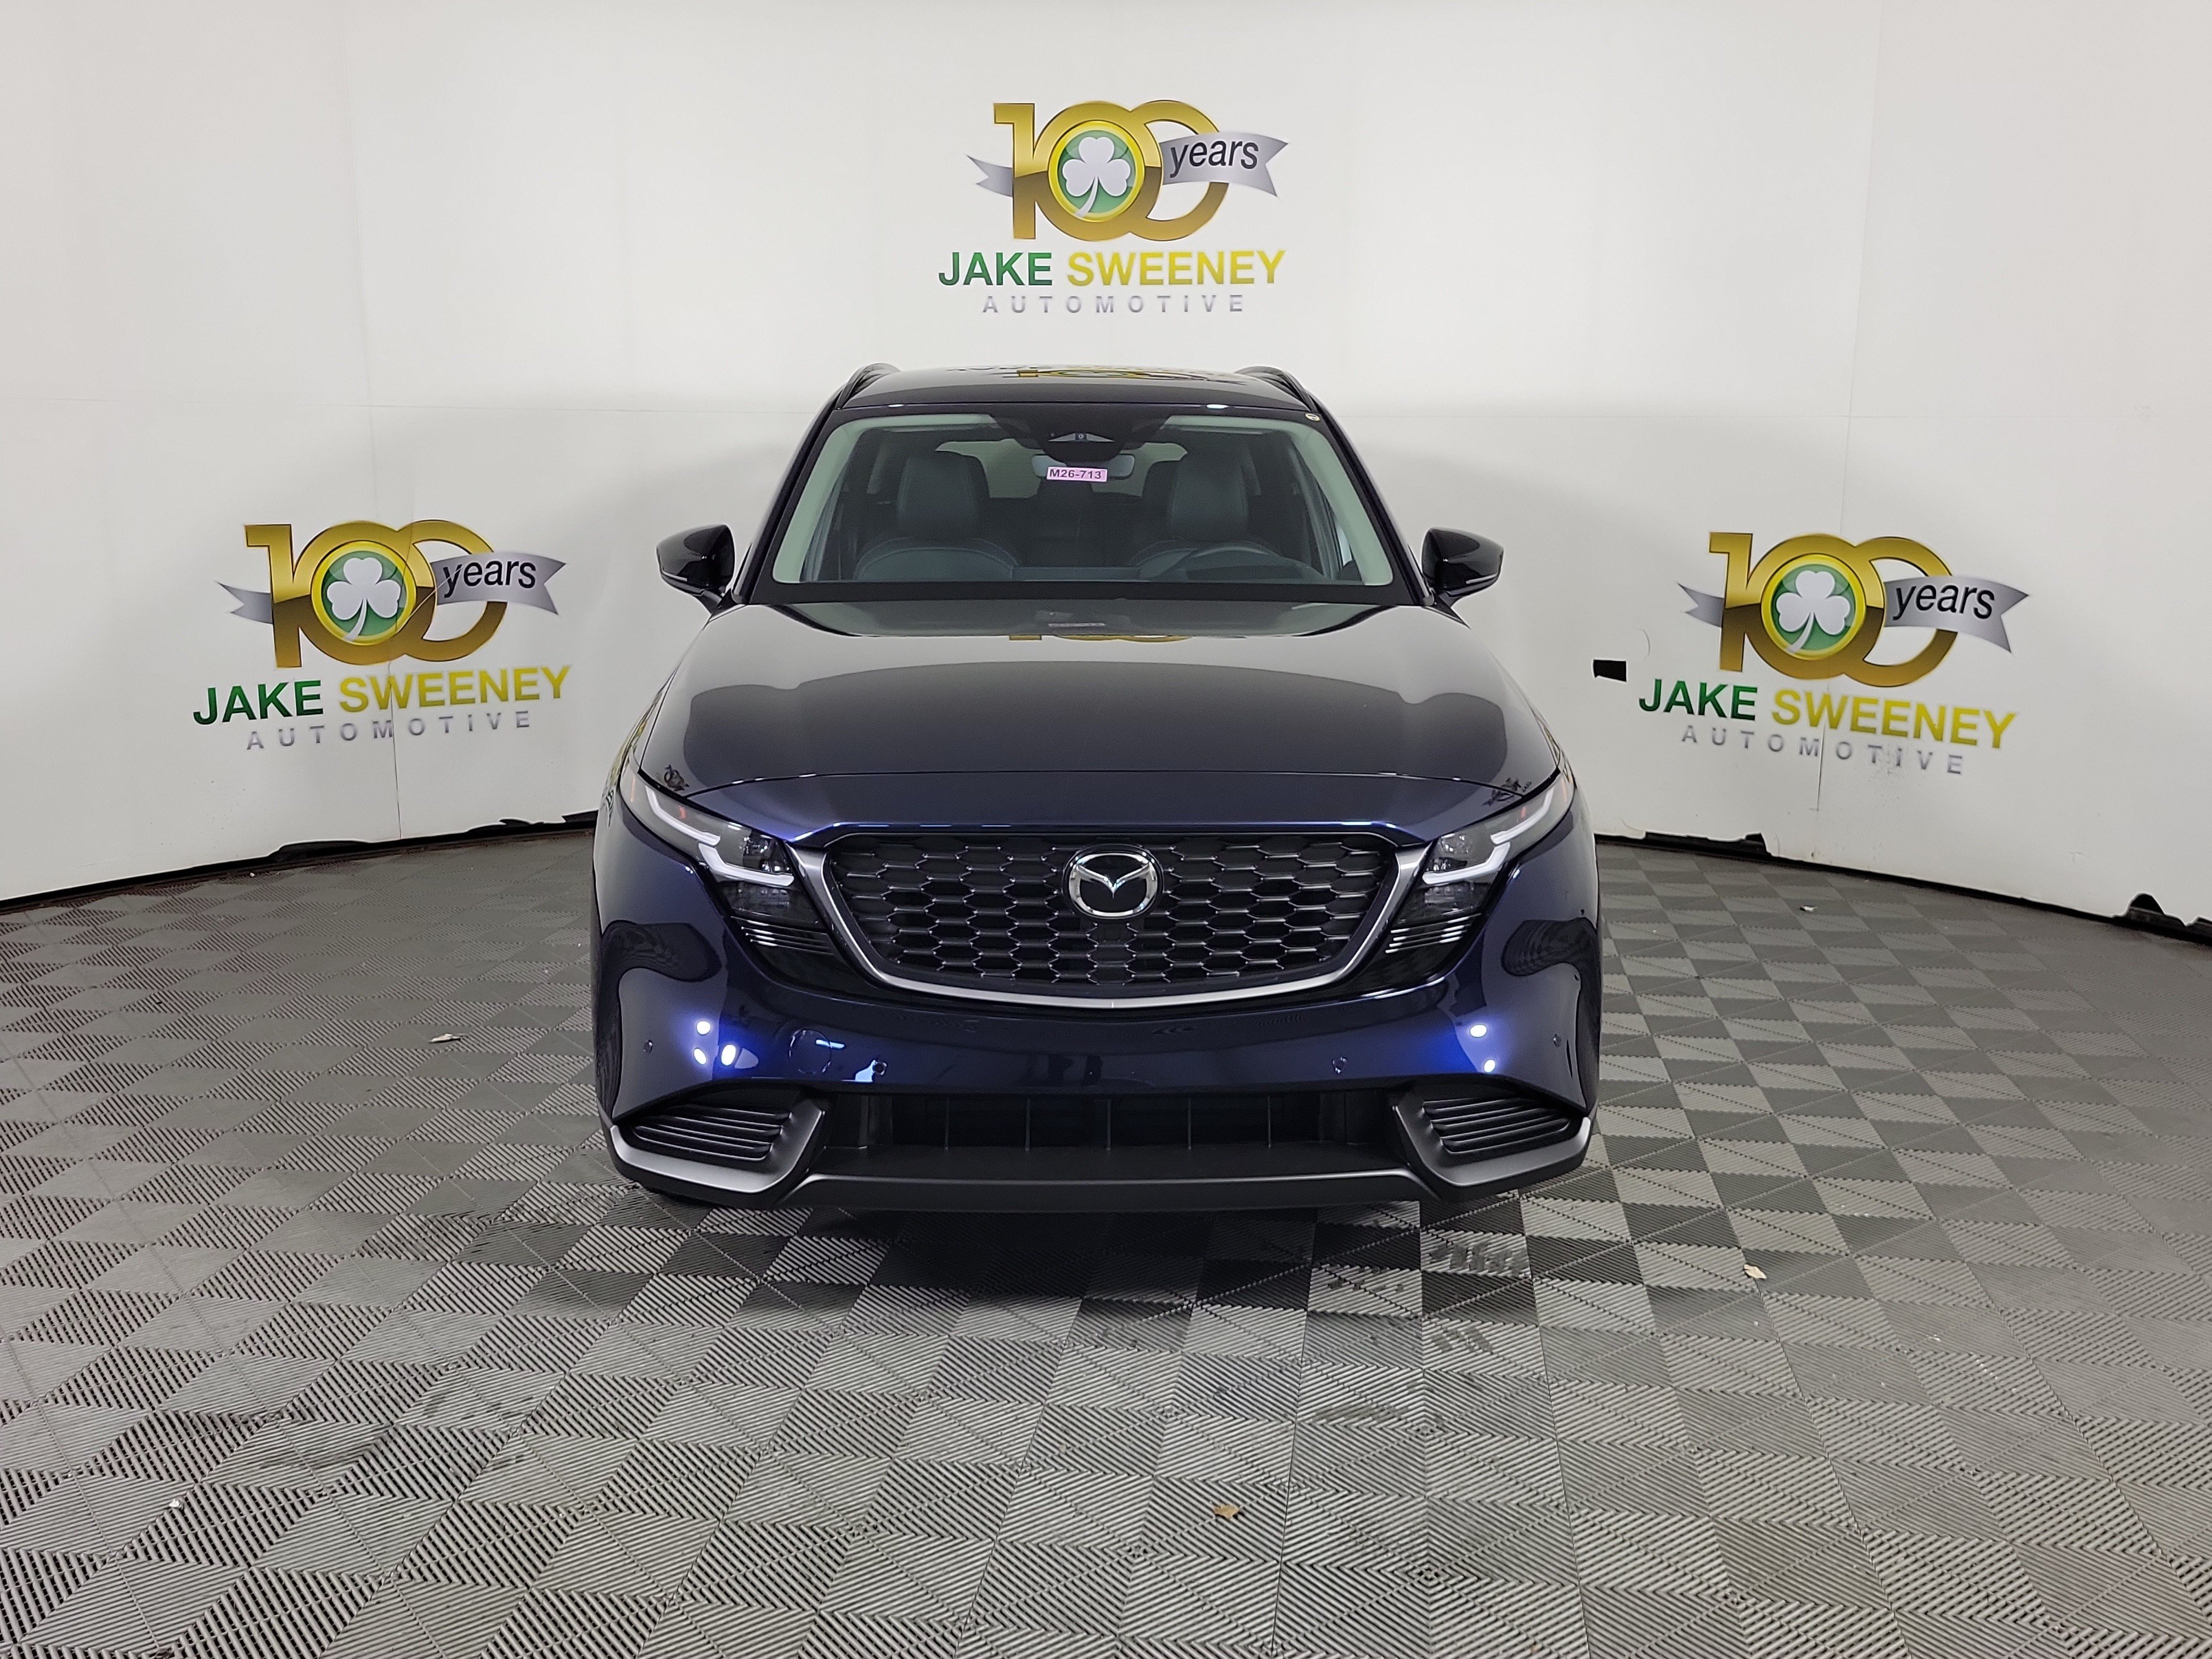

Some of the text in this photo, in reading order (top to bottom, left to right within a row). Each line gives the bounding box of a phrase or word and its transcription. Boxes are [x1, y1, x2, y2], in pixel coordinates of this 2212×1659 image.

[994, 100, 1259, 241] 100 years
[939, 250, 1285, 286] JAKE SWEENEY
[982, 295, 1243, 314] AUTOMOTIVE
[1049, 469, 1102, 479] M26-713
[244, 519, 537, 668] 100 years
[1709, 532, 1995, 687] 100 years
[193, 665, 571, 725] JAKE SWEENEY
[1639, 679, 2016, 749] JAKE SWEENEY
[246, 710, 530, 751] AUTOMOTIVE
[1681, 725, 1963, 775] AUTOMOTIVE
